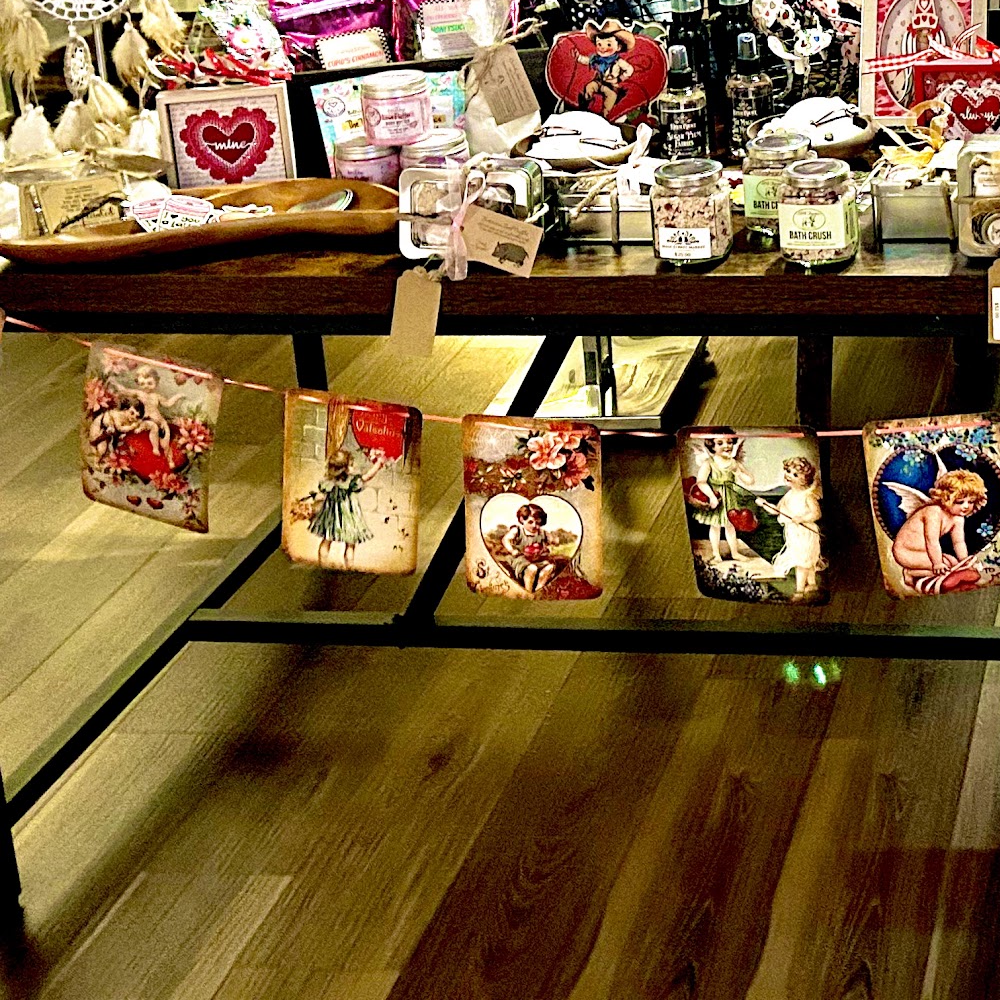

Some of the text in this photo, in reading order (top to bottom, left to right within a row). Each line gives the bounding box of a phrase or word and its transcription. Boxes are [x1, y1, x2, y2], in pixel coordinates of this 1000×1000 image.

[208, 138, 251, 151] mine
[753, 200, 770, 210] BATH
[789, 230, 832, 240] BATH CRUSH
